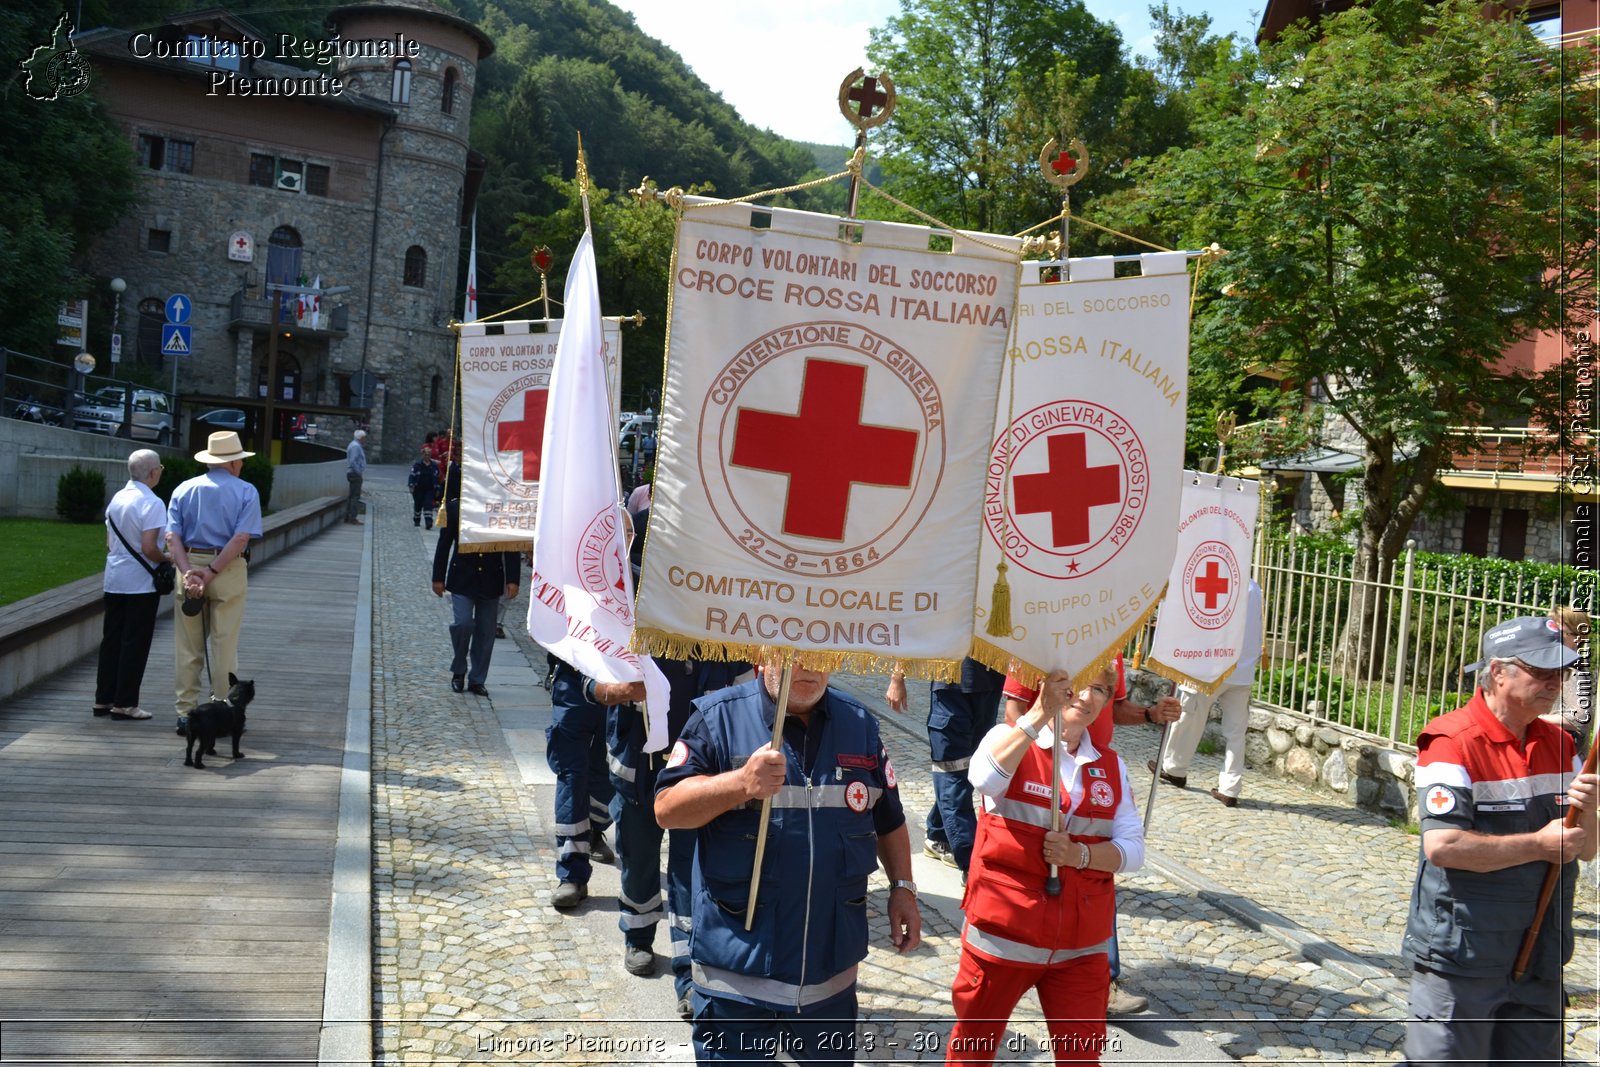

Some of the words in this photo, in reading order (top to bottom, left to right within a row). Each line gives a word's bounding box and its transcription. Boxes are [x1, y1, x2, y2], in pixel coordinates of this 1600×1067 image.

[695, 239, 752, 268] CORPO
[762, 248, 857, 281] VOLONTARI
[868, 264, 901, 288] DEL
[909, 269, 998, 297] SOCCORSO
[678, 268, 774, 301] CROCE
[784, 283, 880, 316] ROSSA
[890, 296, 1009, 329] ITALIANA
[1044, 301, 1074, 316] DEL
[1083, 293, 1171, 313] SOCCORSO
[463, 358, 508, 372] CROCE
[512, 358, 554, 371] ROSSA
[469, 346, 497, 357] CORPO
[500, 344, 543, 356] VOLONTARI
[711, 326, 850, 405] CONVENZIONE
[859, 333, 881, 355] DI
[886, 350, 941, 432] GINEVRA
[1008, 336, 1088, 367] ROSSA
[1100, 339, 1182, 408] ITALIANA
[487, 375, 544, 424] CONVENZIONE
[1032, 406, 1104, 430] GINEVRA
[1012, 422, 1031, 442] DI
[1106, 418, 1127, 441] 22
[1121, 437, 1146, 509] AGOSTO
[985, 439, 1029, 558] CONVENZIONE
[1110, 513, 1136, 547] 1864
[1178, 507, 1208, 533] VOLONTARI
[1209, 506, 1221, 515] DEL
[1223, 508, 1251, 539] SOCCORSO
[583, 514, 615, 592] CONVENZIO
[1184, 545, 1217, 585] CONVENZIONE
[668, 566, 795, 603] COMITATO
[805, 587, 903, 611] LOCALE
[914, 592, 938, 612] DI
[1024, 593, 1092, 615] GRUPPO
[1098, 589, 1113, 602] DI
[705, 607, 900, 646] RACCONIGI
[1052, 582, 1155, 649] TORINESE
[1173, 648, 1203, 660] Gruppo
[1204, 648, 1212, 658] di
